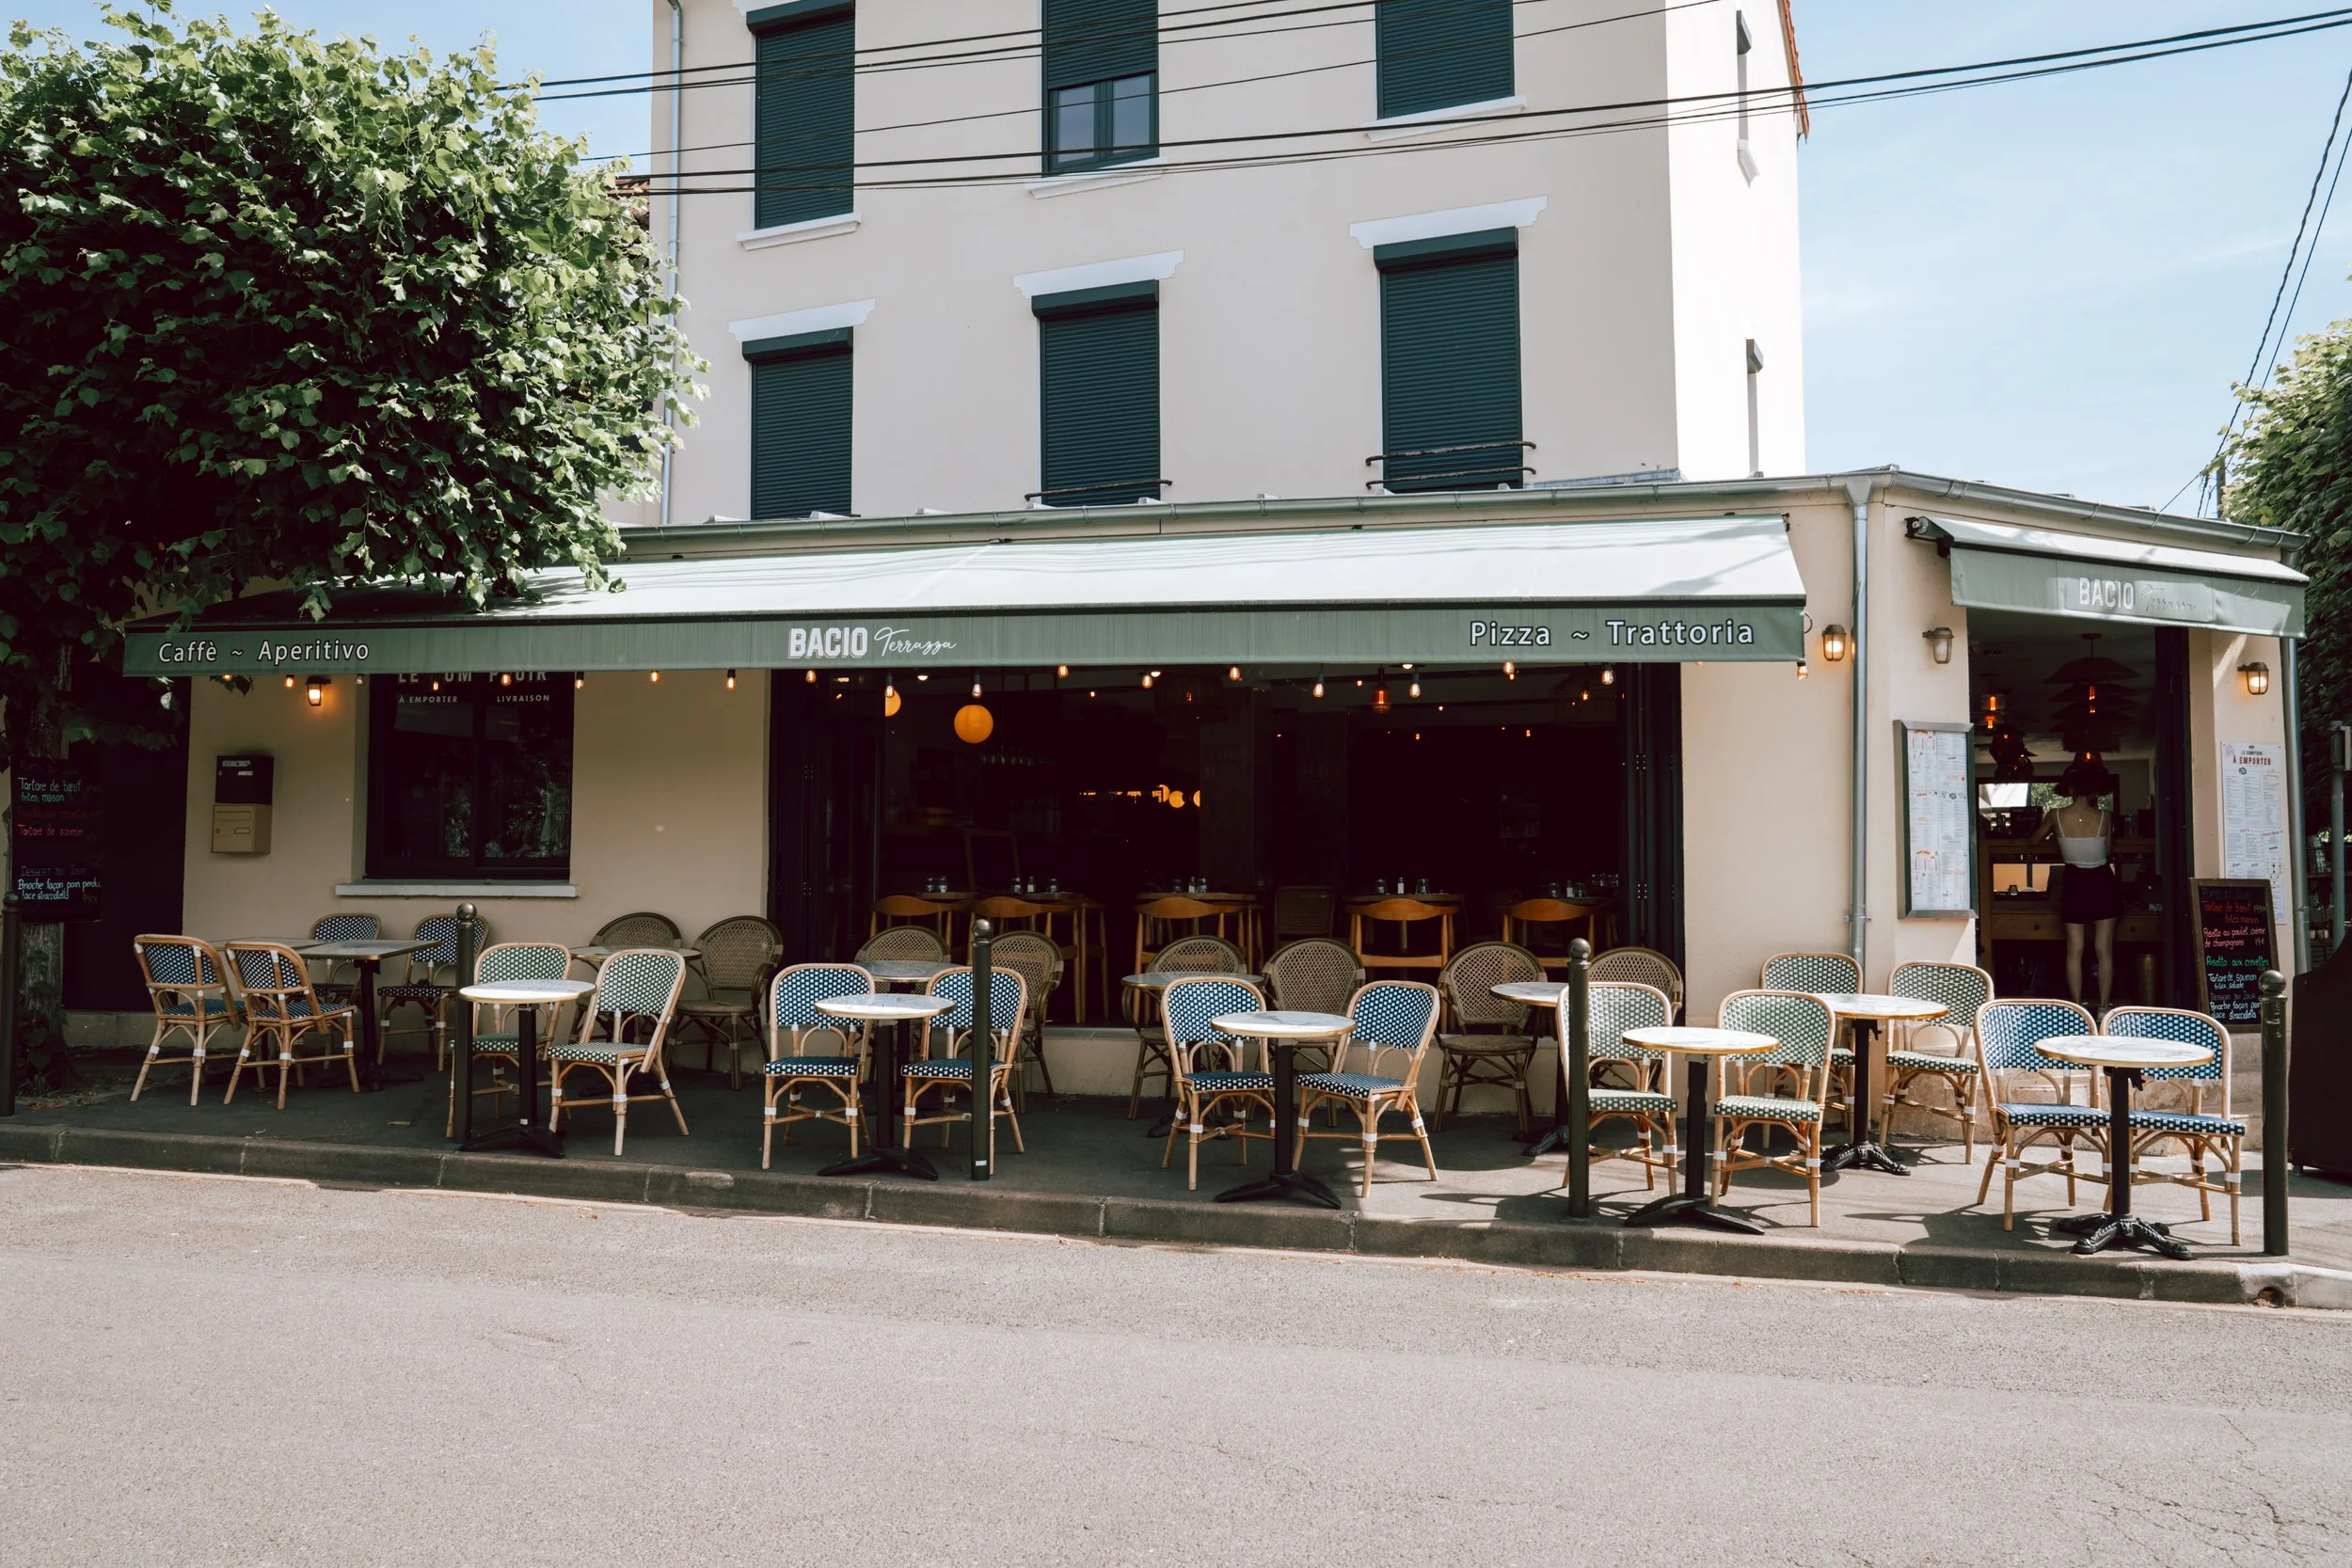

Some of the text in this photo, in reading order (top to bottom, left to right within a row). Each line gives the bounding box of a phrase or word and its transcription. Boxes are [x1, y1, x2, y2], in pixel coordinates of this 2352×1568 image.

[2079, 578, 2135, 610] BACIO
[1470, 621, 1551, 646] Pizza
[1605, 619, 1755, 646] Trattoria
[788, 626, 957, 658] BACIO Terrazza
[158, 640, 217, 663] Caffè
[257, 640, 370, 666] Aperitivo
[399, 672, 547, 683] LE OMPOIR
[409, 695, 458, 704] EMPORTER
[497, 694, 549, 704] LIVRAISON
[2239, 756, 2271, 766] EMPORTER
[18, 777, 46, 792] Tartare
[50, 779, 59, 792] de
[41, 794, 64, 803] maison
[18, 821, 84, 837] Tartare de saumon
[17, 878, 44, 891] Brioche
[2204, 937, 2211, 948] de
[2206, 955, 2228, 968] Risotto
[2232, 958, 2244, 967] aux
